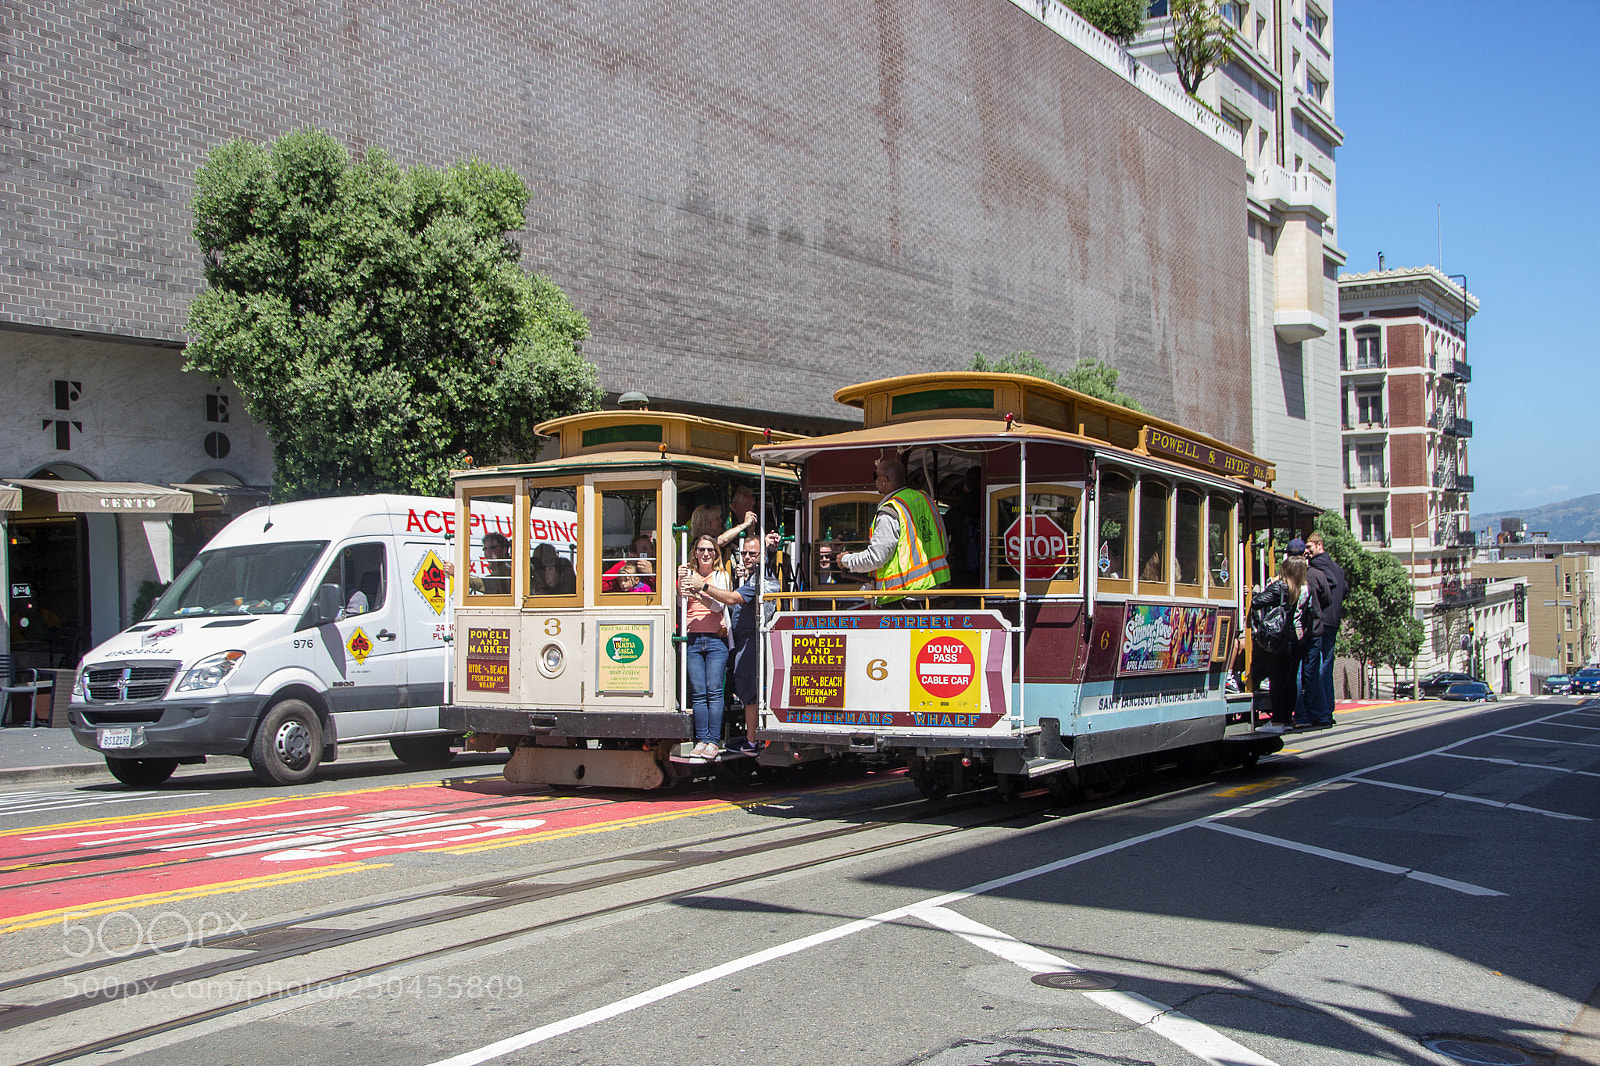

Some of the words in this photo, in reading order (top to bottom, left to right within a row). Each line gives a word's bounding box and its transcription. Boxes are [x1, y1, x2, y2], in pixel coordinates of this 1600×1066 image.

[1151, 431, 1200, 459] POWELL
[1207, 449, 1217, 465] &
[1224, 455, 1250, 475] HYDE
[100, 497, 157, 509] CENTO
[406, 508, 455, 534] ACE
[1008, 535, 1064, 561] STOP
[421, 567, 446, 583] ACE
[544, 618, 562, 636] 3
[794, 616, 861, 629] MARKET
[879, 615, 955, 629] STREET
[962, 616, 974, 628] &
[470, 630, 509, 640] POWELL
[1100, 630, 1110, 650] 6
[293, 639, 314, 649] 976
[351, 636, 369, 647] ACE
[479, 638, 499, 646] AND
[794, 637, 844, 647] POWELL
[469, 645, 510, 654] MARKET
[806, 647, 831, 655] AND
[927, 644, 943, 654] DO
[943, 644, 964, 654] NOT
[793, 655, 844, 665] MARKET
[933, 653, 958, 663] PASS
[468, 664, 482, 673] HYDE
[489, 664, 508, 675] BEACH
[866, 658, 889, 681] 6
[471, 674, 505, 683] FISHERMANS
[792, 676, 810, 686] HYDE
[820, 676, 843, 687] BEACH
[921, 675, 949, 685] CABLE
[950, 675, 969, 686] CAR
[478, 681, 497, 689] WHARF
[796, 688, 838, 697] FISHERMANS
[805, 696, 827, 704] WHARF
[1098, 697, 1113, 711] SAN
[786, 709, 894, 725] FISHERMANS
[914, 712, 981, 727] WHARF
